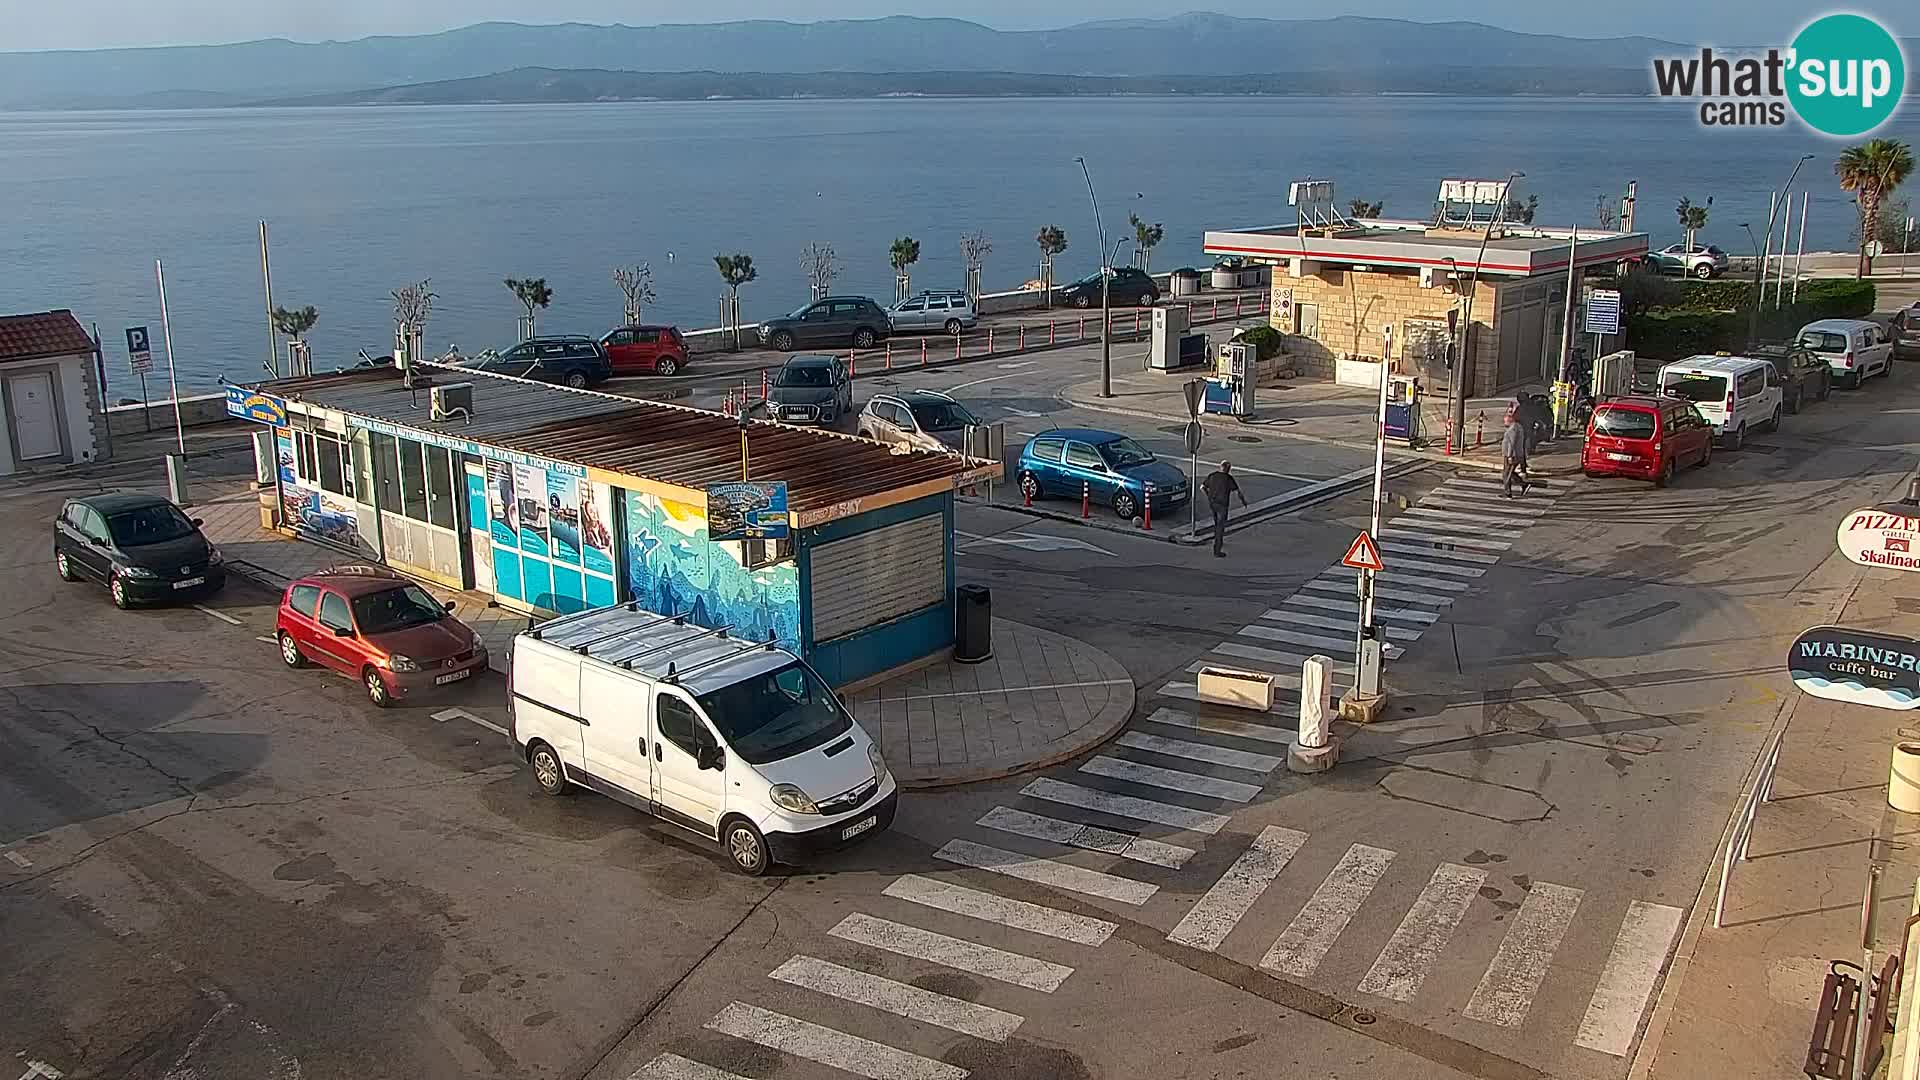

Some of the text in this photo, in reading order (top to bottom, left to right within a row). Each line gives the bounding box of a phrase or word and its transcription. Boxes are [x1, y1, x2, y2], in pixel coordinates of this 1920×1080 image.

[131, 331, 143, 349] P
[437, 437, 468, 450] POSTAJA
[478, 445, 494, 457] BUS
[495, 447, 526, 464] STATION
[528, 456, 554, 470] TICKET
[555, 462, 583, 476] OFFICE
[1848, 515, 1920, 533] PIZZE
[1882, 531, 1916, 540] GRILL
[1829, 662, 1897, 681] caffe bar
